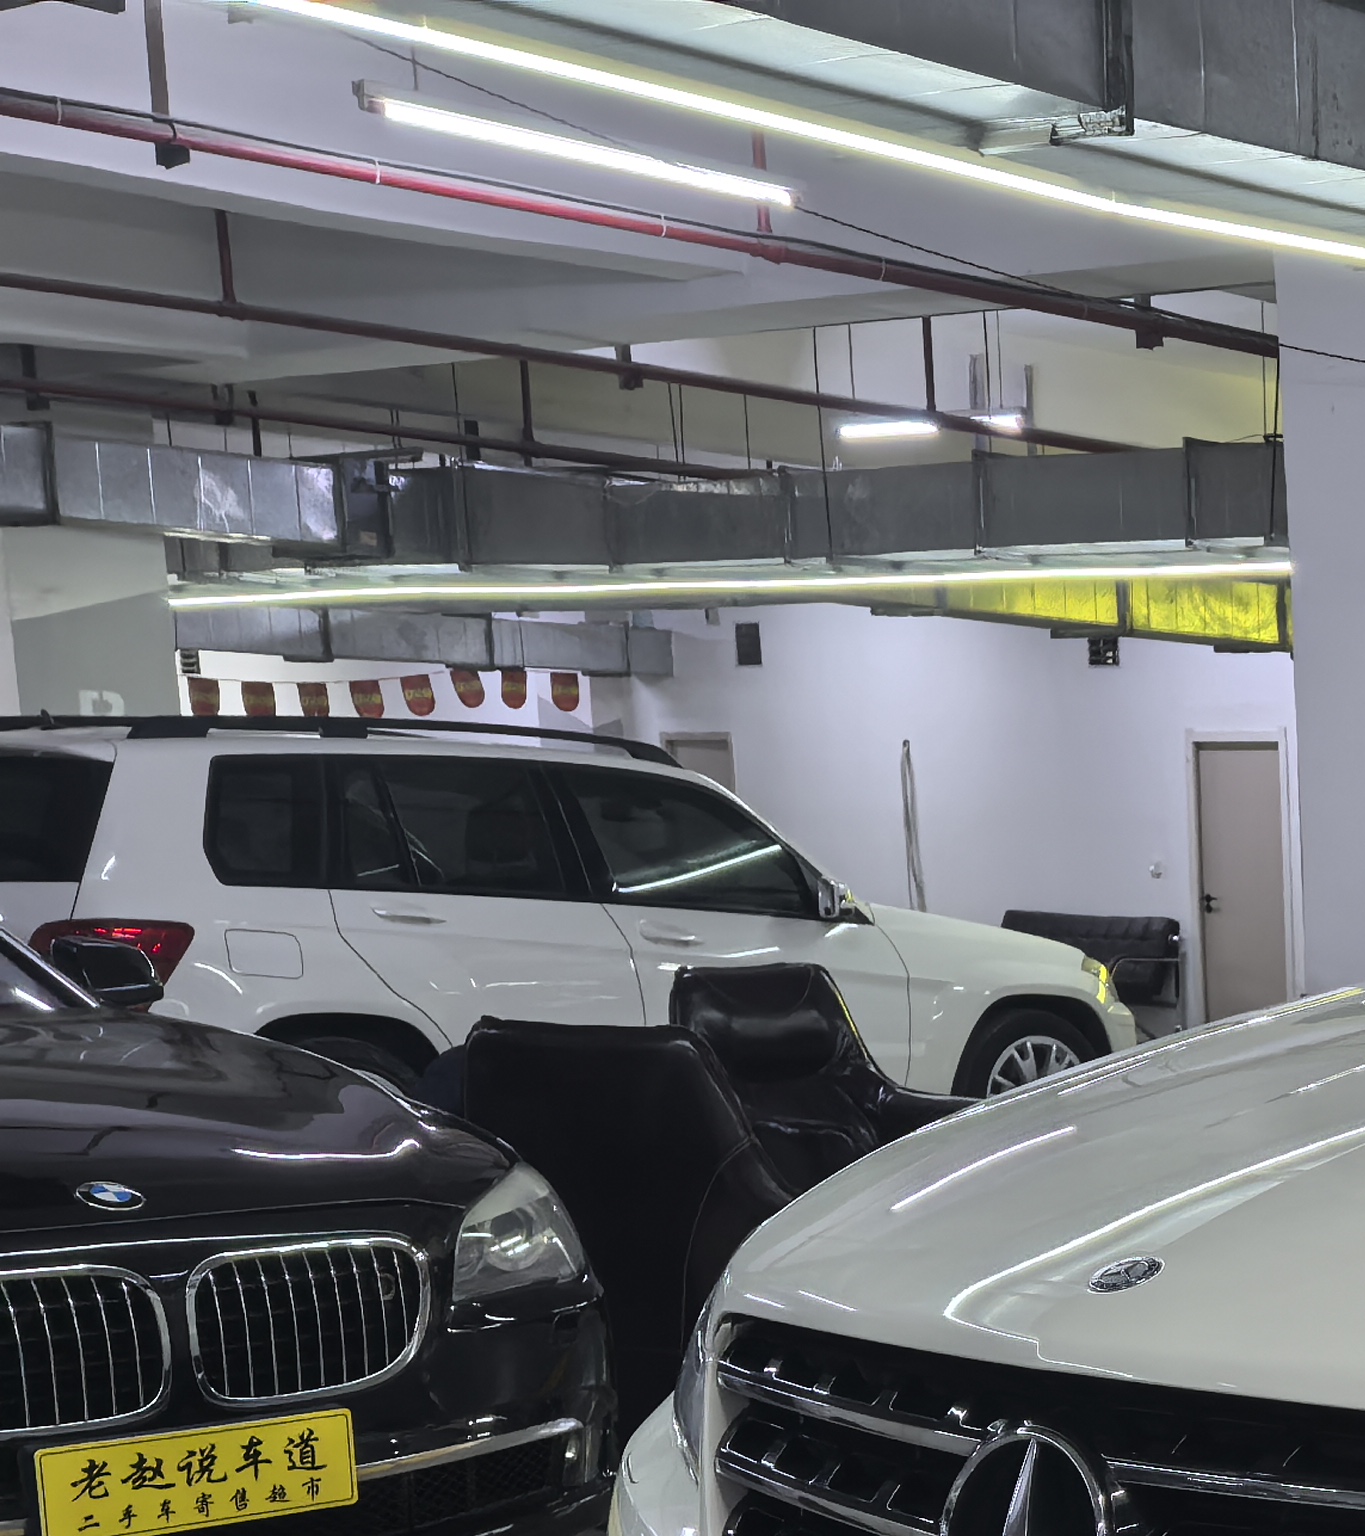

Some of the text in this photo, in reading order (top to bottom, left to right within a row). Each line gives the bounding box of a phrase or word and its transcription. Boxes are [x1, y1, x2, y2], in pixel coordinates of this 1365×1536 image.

[71, 1427, 328, 1503] 老赵说车道
[77, 1476, 323, 1533] 二手车寄售超市
